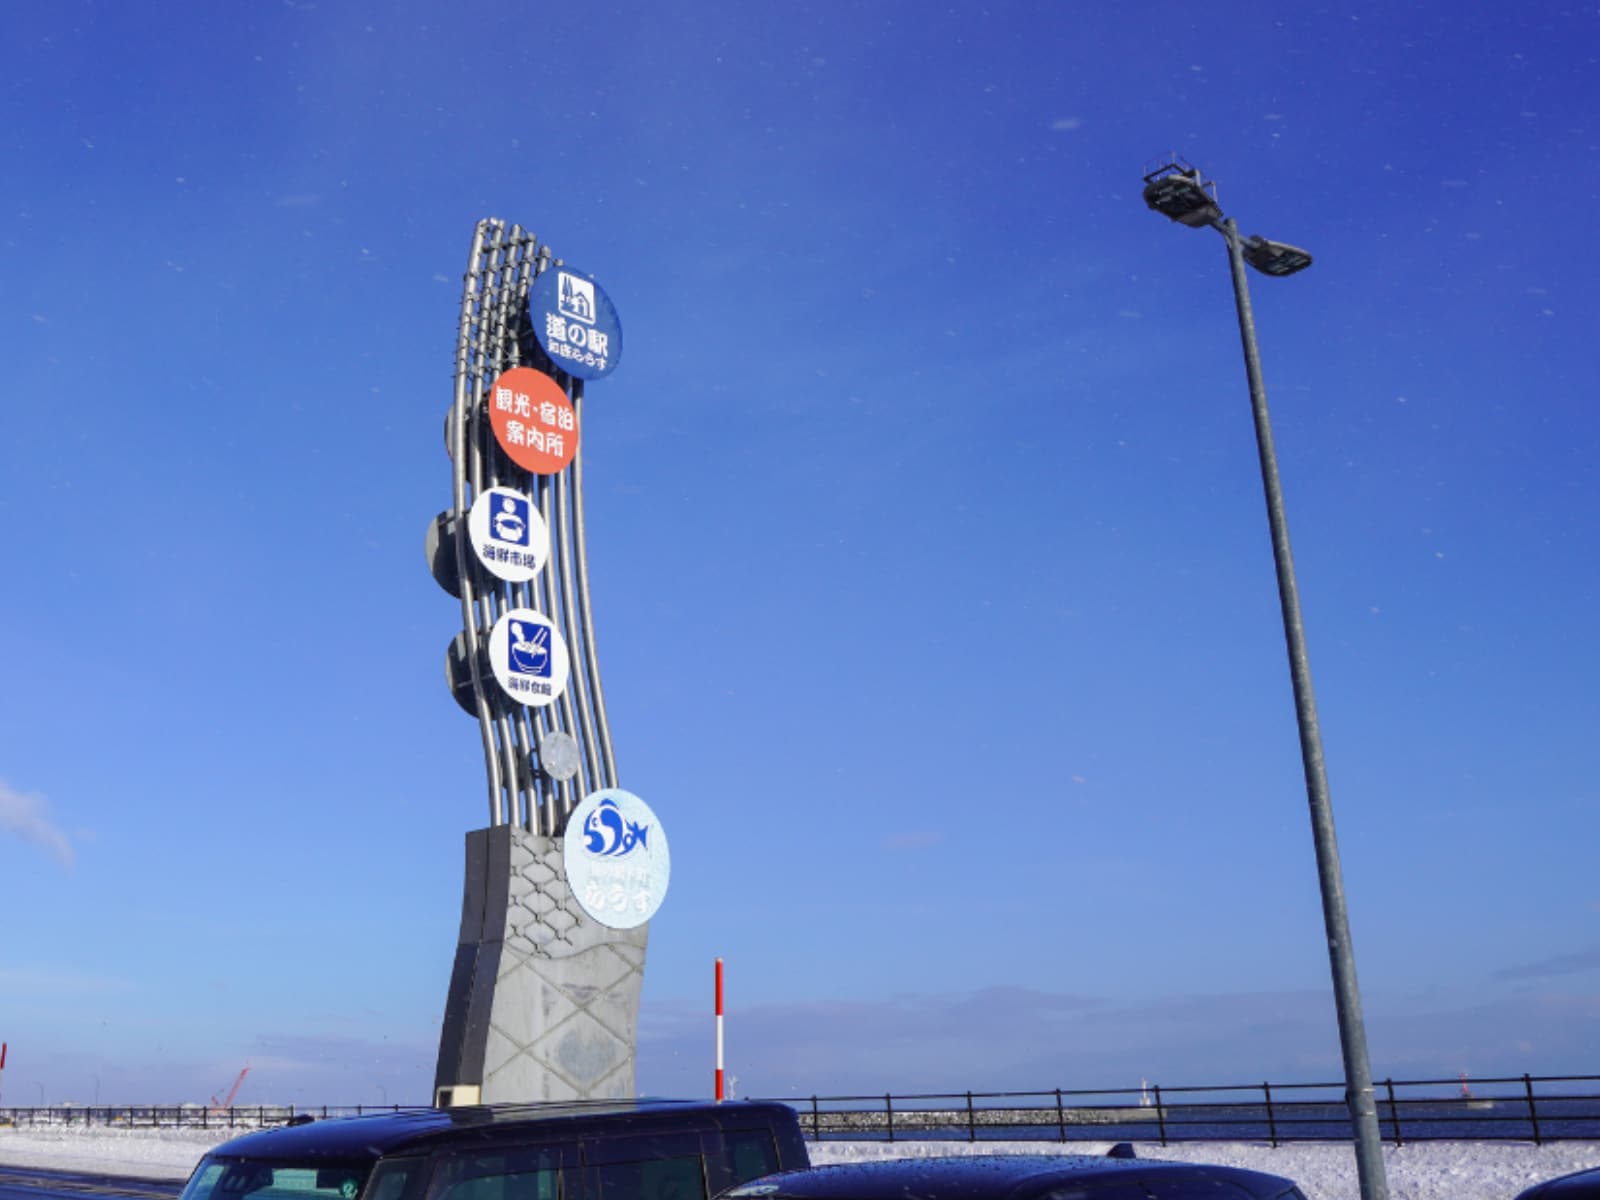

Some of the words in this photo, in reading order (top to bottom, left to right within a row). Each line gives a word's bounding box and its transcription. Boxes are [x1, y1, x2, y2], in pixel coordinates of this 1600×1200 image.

[546, 312, 608, 357] 道の駅
[506, 420, 563, 458] 案内所
